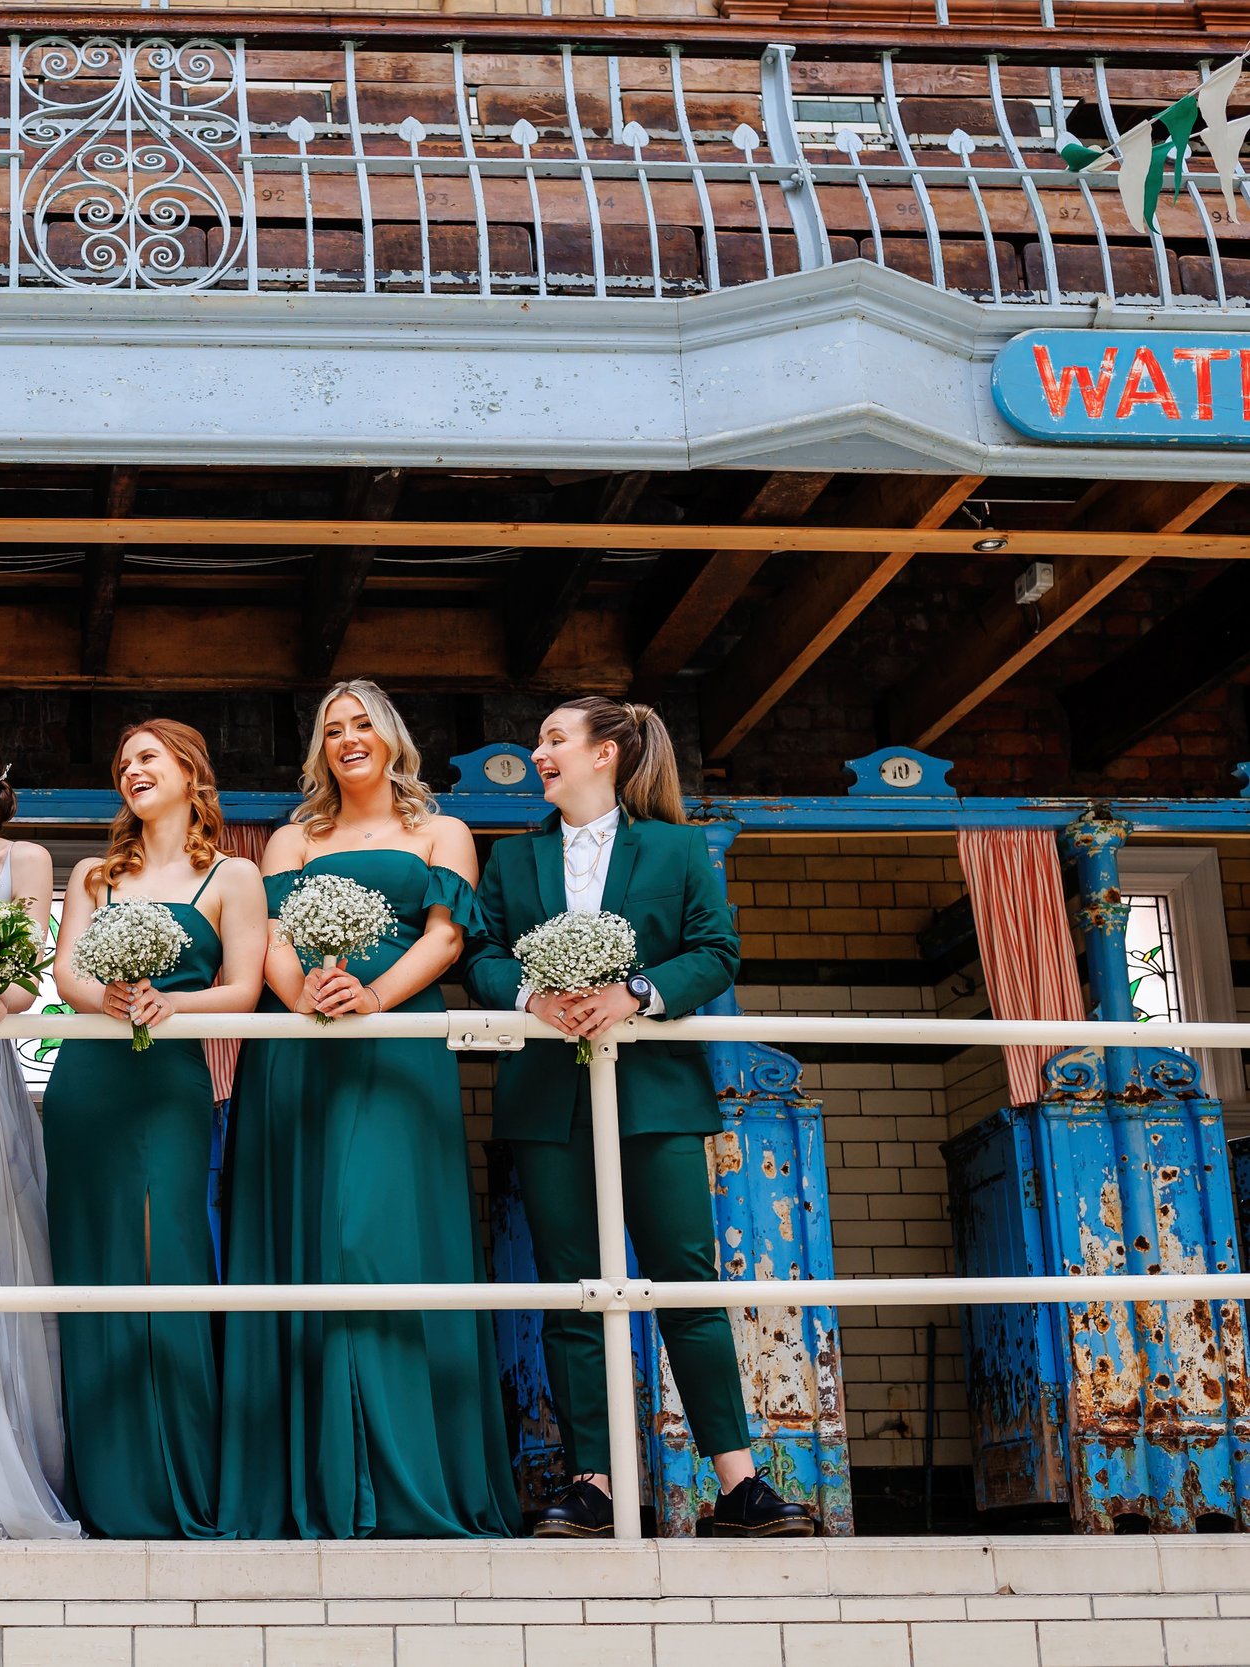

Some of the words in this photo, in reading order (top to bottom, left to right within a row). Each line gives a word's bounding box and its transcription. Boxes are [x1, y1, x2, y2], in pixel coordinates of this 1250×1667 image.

[262, 189, 286, 202] 92
[425, 193, 449, 206] 93
[896, 203, 918, 216] 96
[1058, 206, 1081, 220] 97
[1033, 344, 1250, 421] WAT
[500, 759, 511, 778] 9
[891, 762, 910, 780] 10
